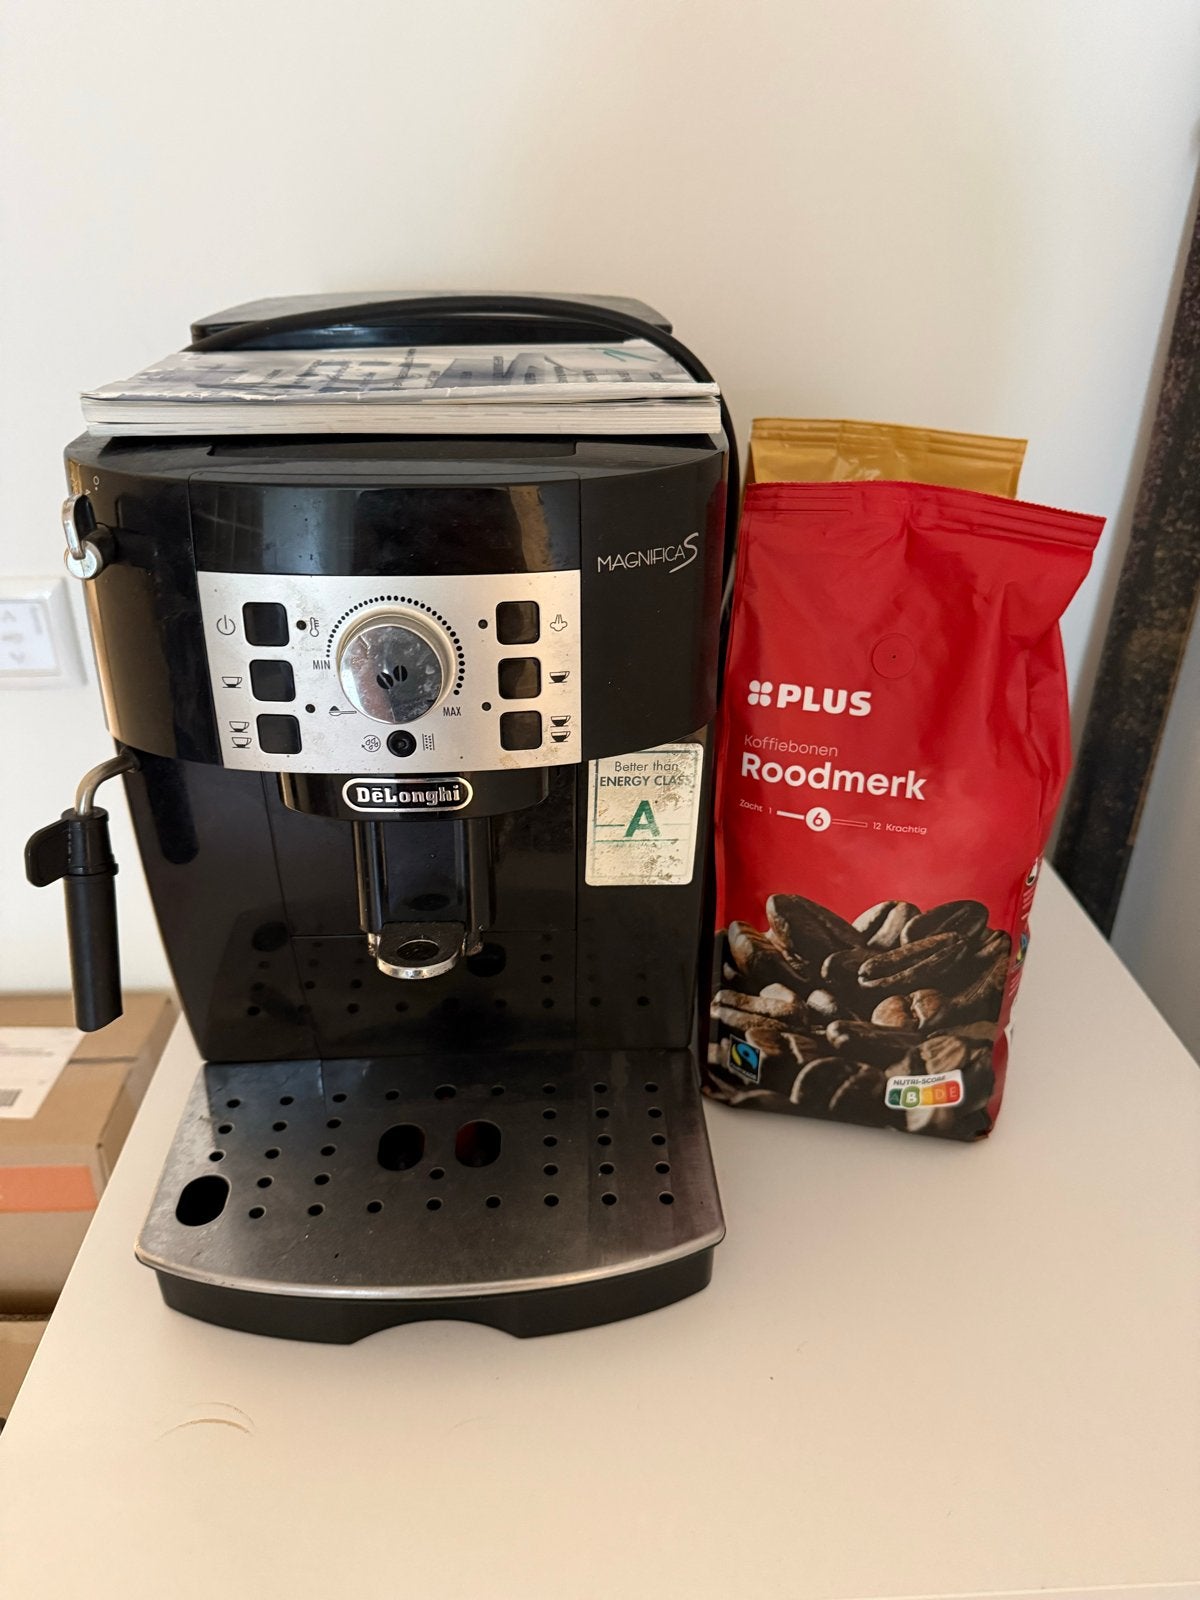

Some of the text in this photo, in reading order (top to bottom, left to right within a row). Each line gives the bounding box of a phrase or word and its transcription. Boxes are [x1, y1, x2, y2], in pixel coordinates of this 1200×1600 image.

[312, 659, 331, 670] MIN
[442, 706, 462, 717] MAX
[776, 683, 872, 717] PLUS
[744, 734, 838, 757] Koffiebonen
[614, 760, 679, 772] Better than
[741, 752, 927, 801] Roodmerk
[600, 775, 650, 787] ENERGY
[624, 800, 661, 838] A
[739, 798, 763, 813] Zacht
[812, 812, 824, 827] 6
[873, 821, 881, 830] 12
[886, 823, 928, 835] Krachtig
